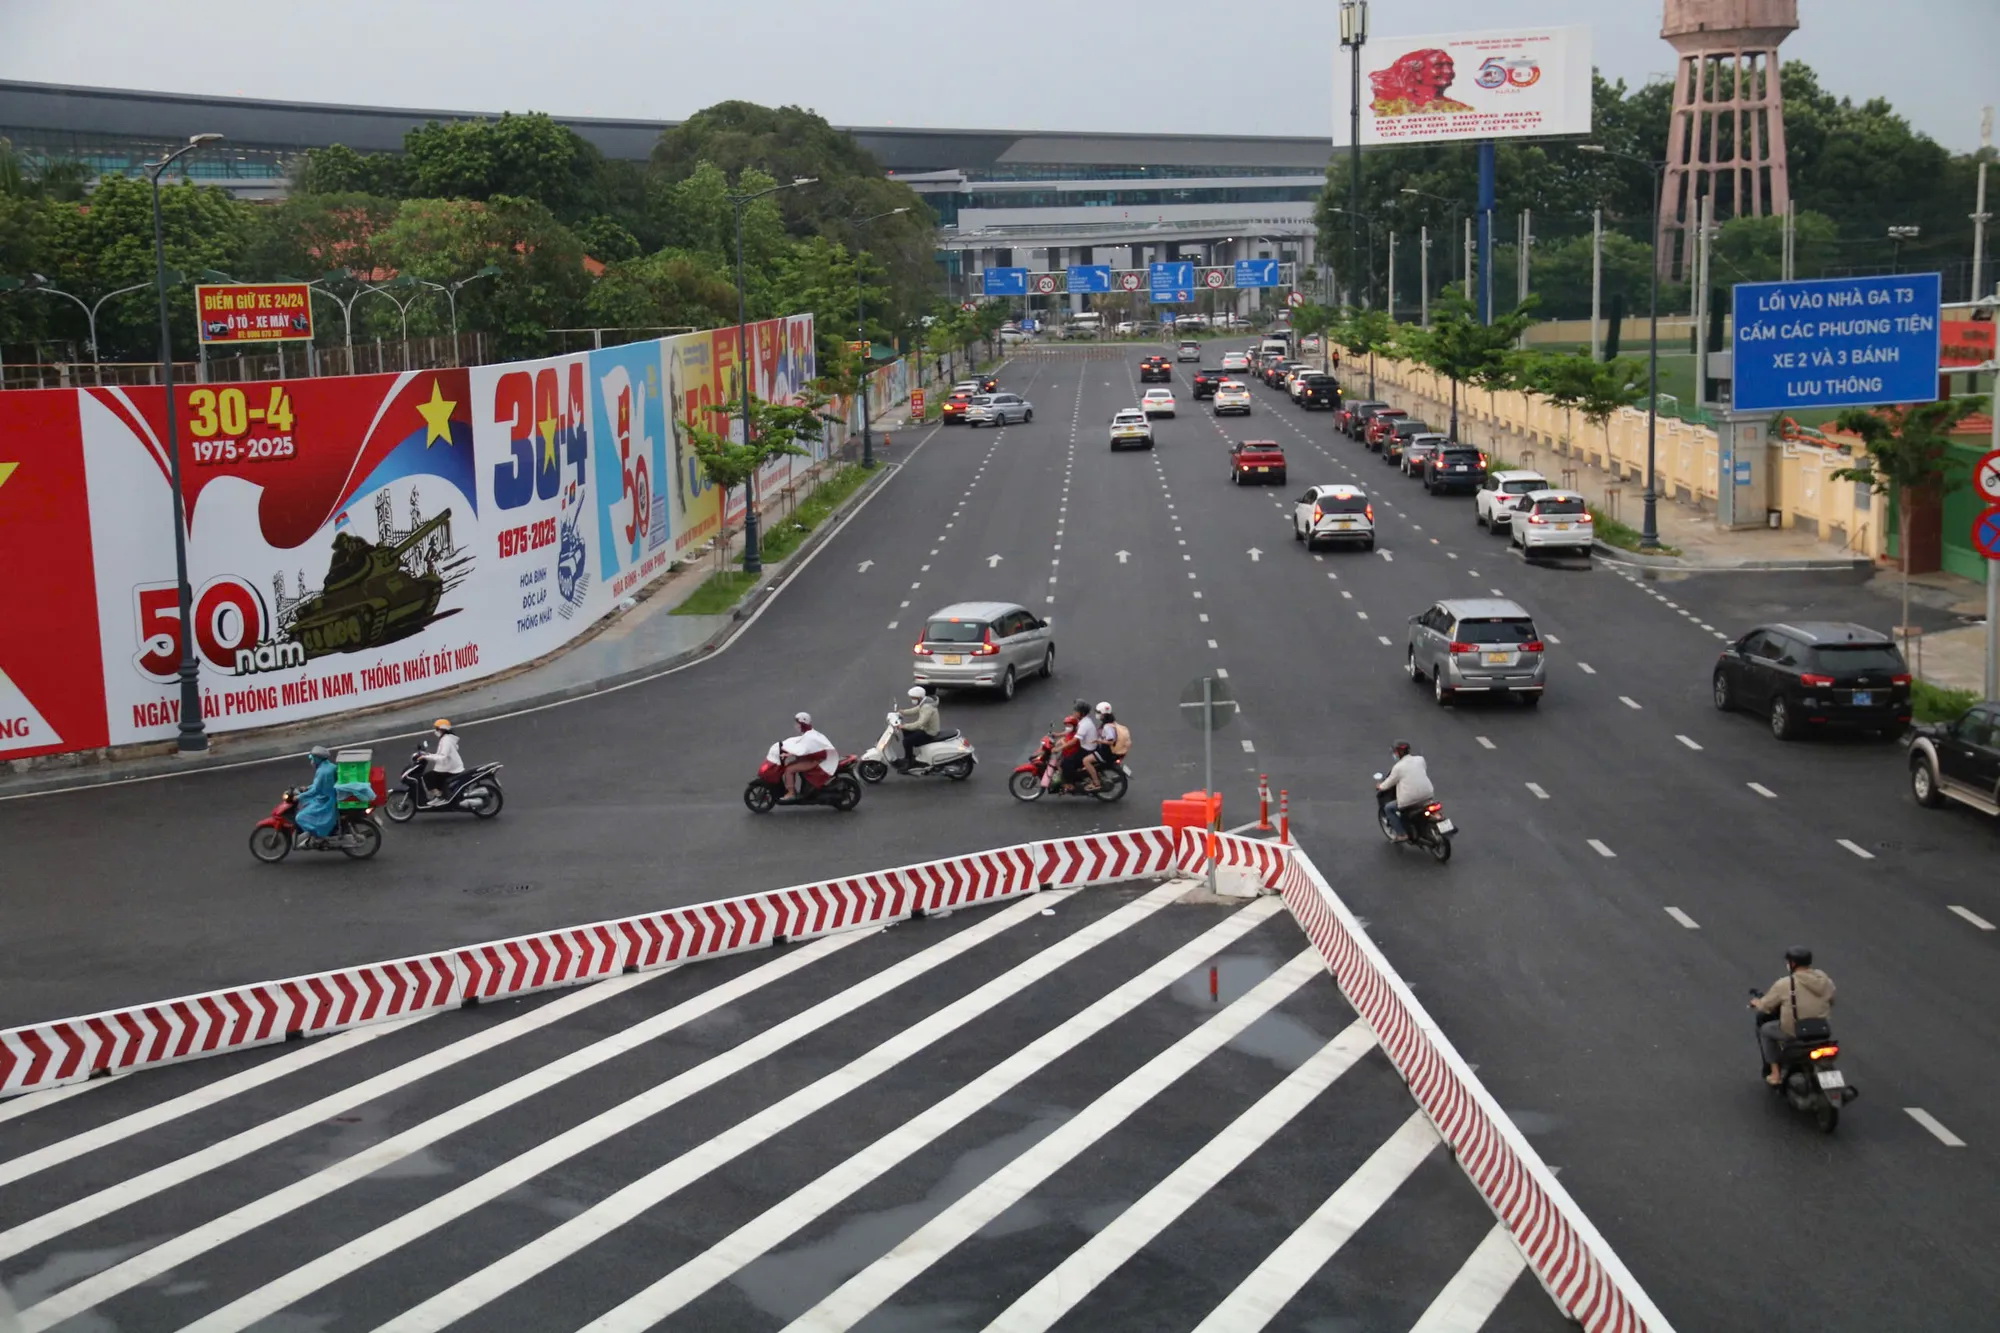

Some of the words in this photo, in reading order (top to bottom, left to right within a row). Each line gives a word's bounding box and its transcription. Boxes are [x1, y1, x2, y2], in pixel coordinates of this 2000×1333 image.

[1041, 280, 1052, 289] 20
[1209, 275, 1221, 284] 20
[205, 290, 234, 310] ĐIỂM
[236, 292, 255, 309] GIỮ
[258, 294, 272, 308] XE
[274, 293, 304, 308] 24/24
[1759, 289, 1785, 312] LỐI
[1790, 290, 1823, 309] VÀO
[1827, 286, 1864, 307] NHÀ
[1868, 290, 1890, 304] GA
[1895, 288, 1914, 303] T3
[236, 314, 248, 328] TÔ
[256, 315, 268, 328] XE
[270, 313, 289, 327] MÁY
[1739, 319, 1776, 341] CẤM
[1780, 320, 1814, 339] CÁC
[1819, 318, 1891, 337] PHƯƠNG
[1895, 313, 1933, 334] TIỆN
[1773, 353, 1794, 369] XE
[1798, 353, 1807, 368] 2
[1811, 350, 1834, 366] VÀ
[1837, 351, 1847, 365] 3
[1852, 346, 1900, 363] BÁNH
[1787, 380, 1822, 397] LƯU
[1825, 376, 1883, 394] THÔNG
[189, 386, 293, 437] 30-4
[192, 436, 294, 461] 1975-2025
[520, 570, 533, 588] HÒA
[534, 566, 548, 584] BÌNH
[522, 594, 536, 609] ĐỘC
[536, 589, 548, 606] LẬP
[138, 578, 261, 676] 50
[517, 613, 538, 633] THỐNG
[538, 606, 553, 626] NHẤT
[235, 638, 305, 674] năm
[133, 696, 180, 728] NGÀY
[225, 684, 277, 716] PHÓNG
[282, 672, 319, 703] MIỀN
[322, 671, 358, 699] NAM,
[360, 656, 401, 691] THỐNG
[403, 647, 432, 683] NHẤT
[433, 641, 453, 676] ĐẤT
[454, 638, 480, 668] NƯỚC
